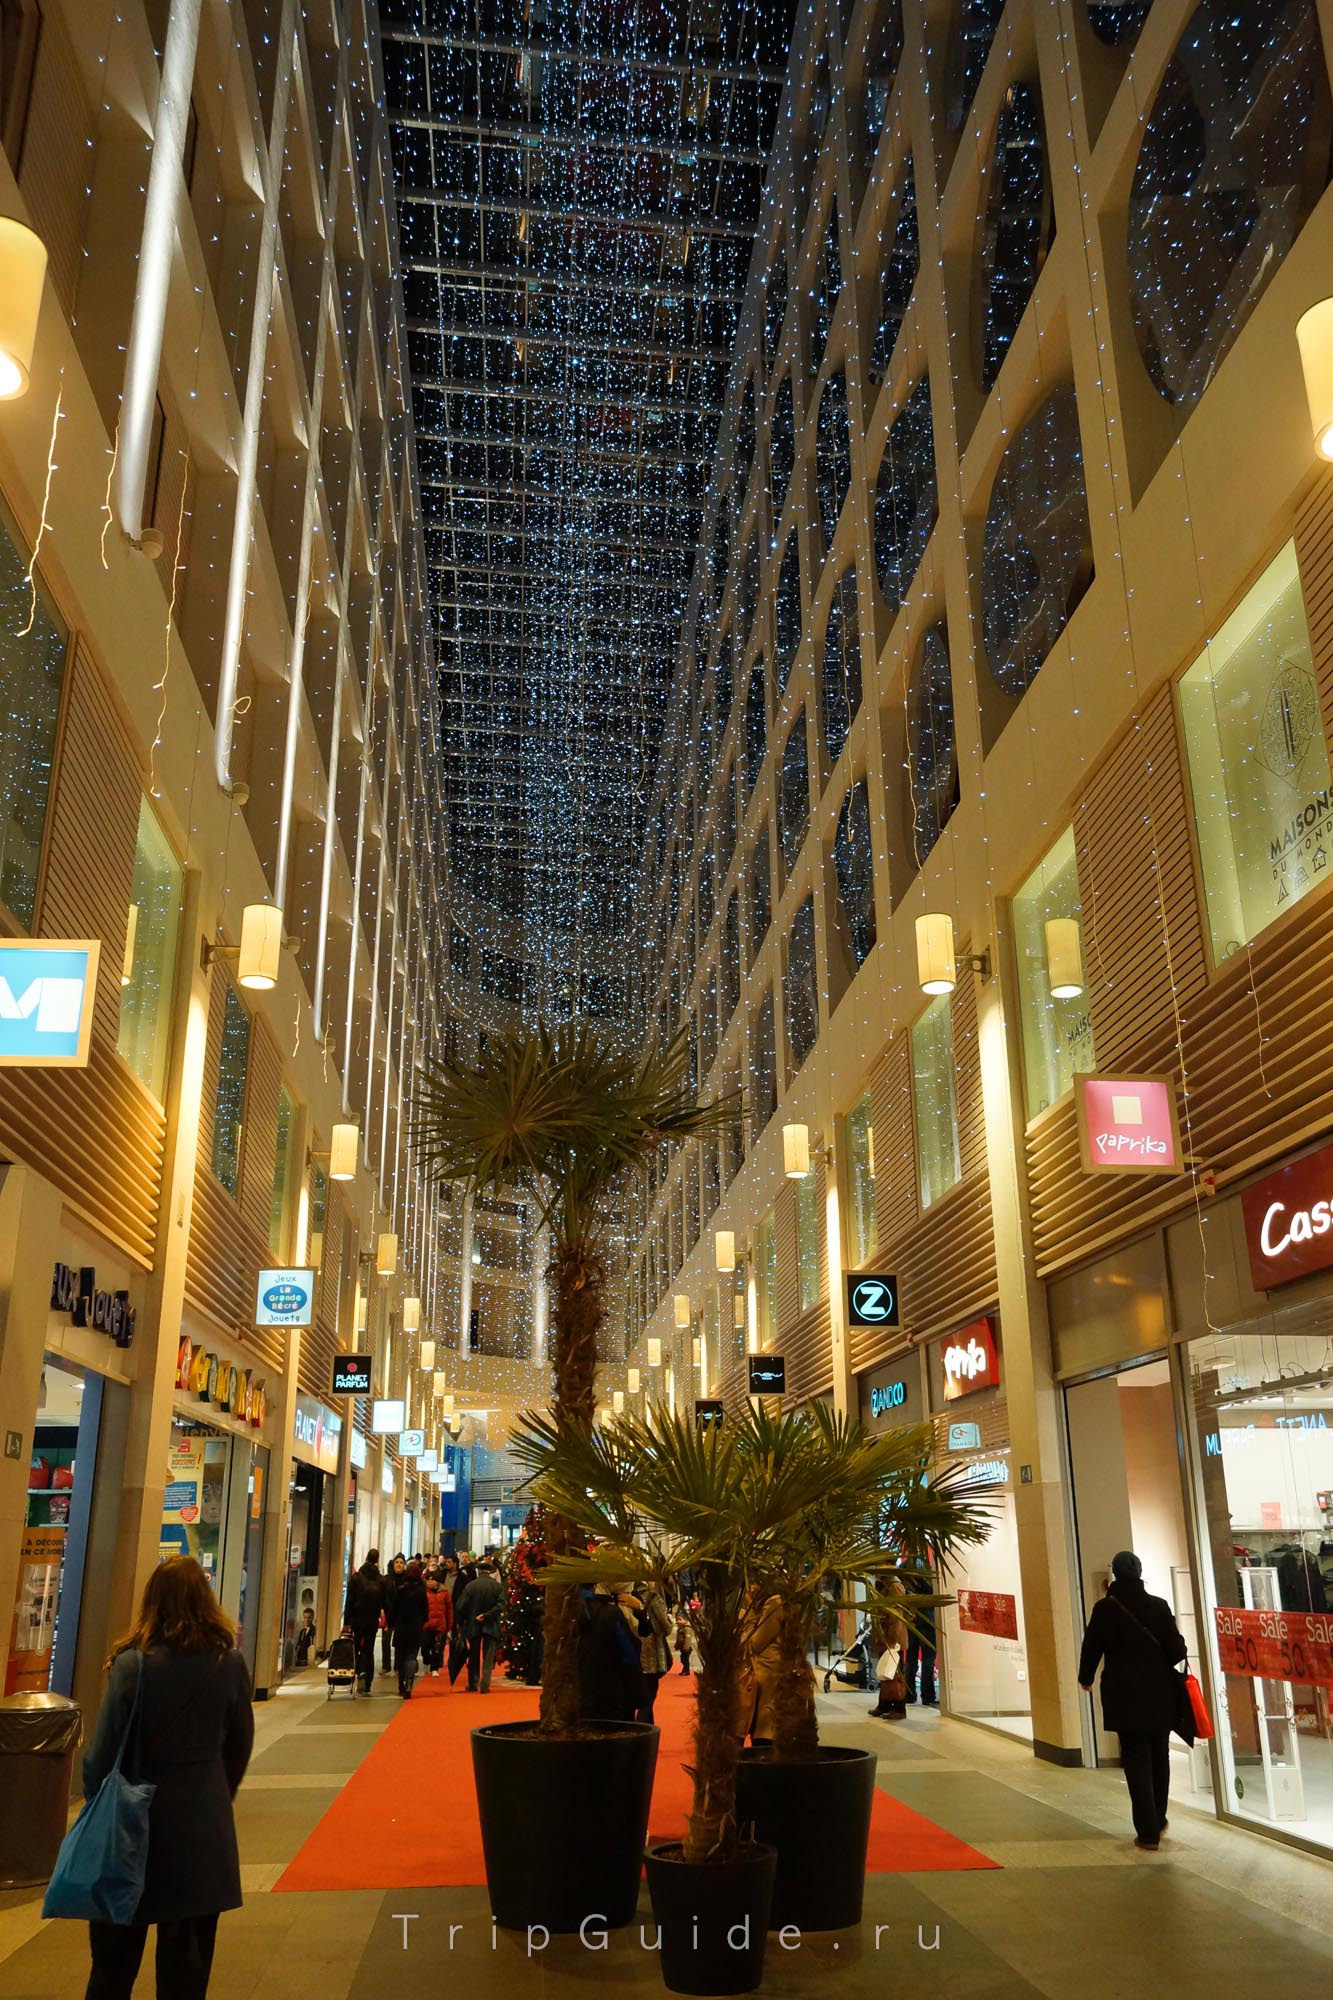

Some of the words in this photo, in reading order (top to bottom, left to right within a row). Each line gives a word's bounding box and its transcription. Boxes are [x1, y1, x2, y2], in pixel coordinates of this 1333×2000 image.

[1260, 1198, 1333, 1257] Cas
[269, 1294, 303, 1302] Grande
[859, 1286, 886, 1315] Z
[336, 1374, 367, 1382] PLANET
[1216, 1610, 1243, 1636] Sale
[1259, 1613, 1288, 1639] Sale
[1235, 1637, 1258, 1671] 50
[1280, 1641, 1305, 1678] 50
